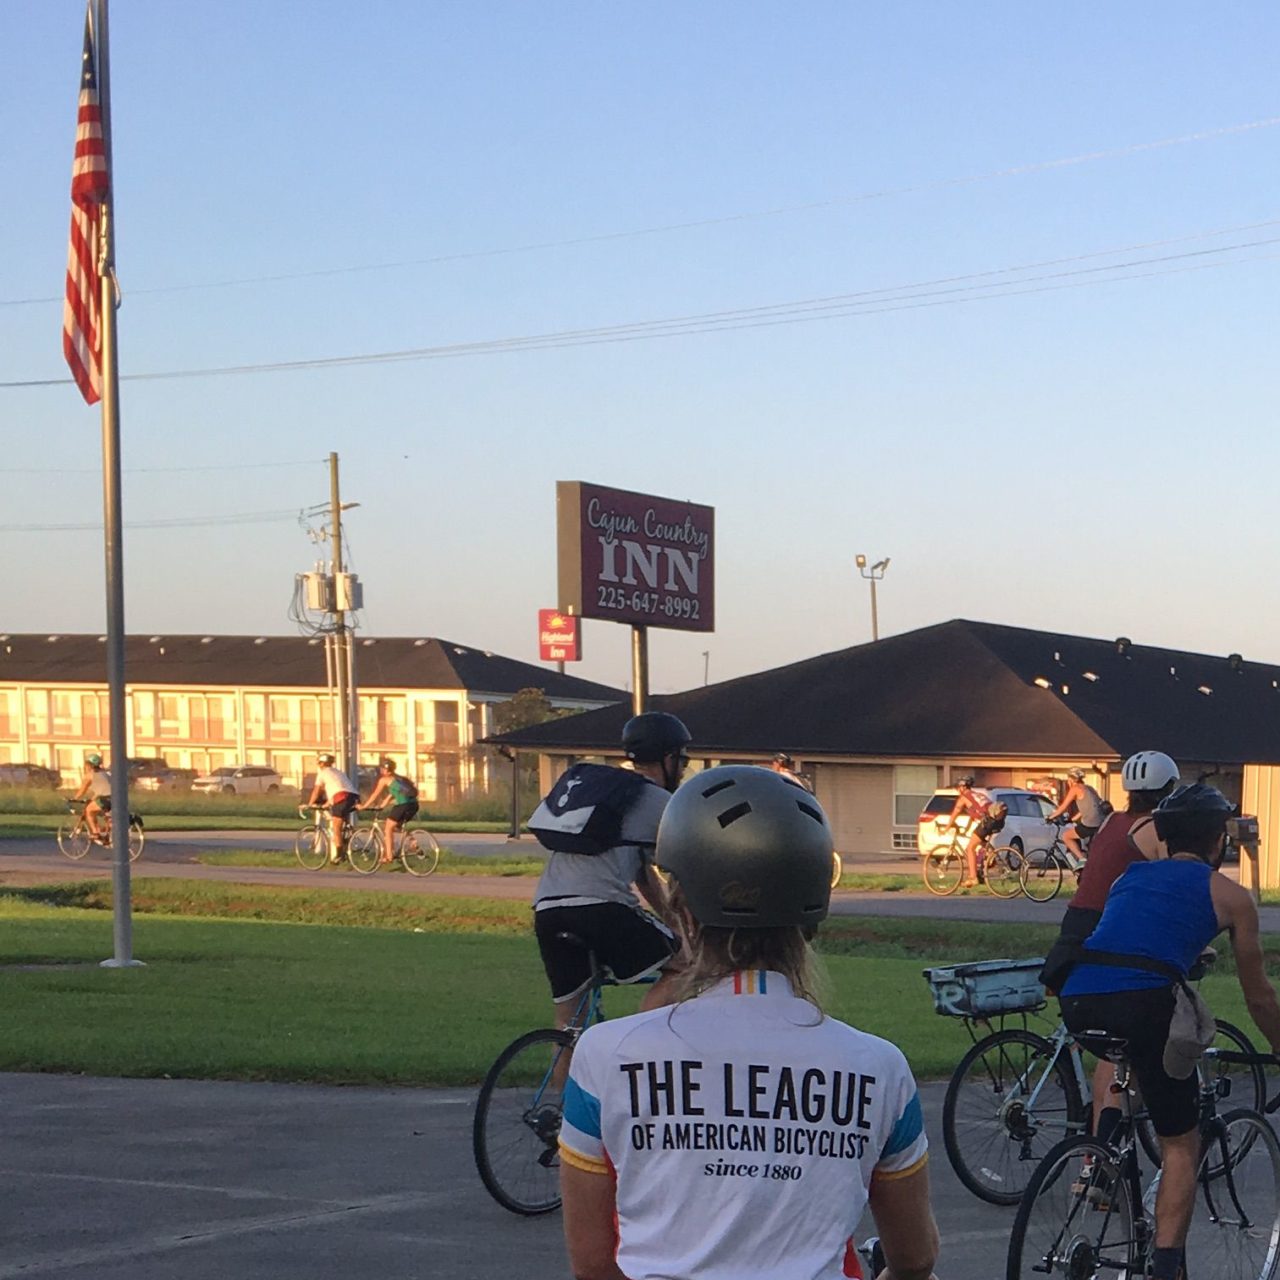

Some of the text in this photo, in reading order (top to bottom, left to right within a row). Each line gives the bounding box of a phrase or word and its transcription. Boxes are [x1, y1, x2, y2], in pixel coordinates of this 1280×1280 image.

[588, 498, 709, 558] Cajun Country
[598, 536, 699, 594] INN
[597, 586, 700, 619] 225-647-8992
[620, 1060, 876, 1130] THE LEAGUE
[631, 1123, 655, 1151] OF
[662, 1123, 766, 1152] AMERICAN
[704, 1158, 802, 1181] since 1880
